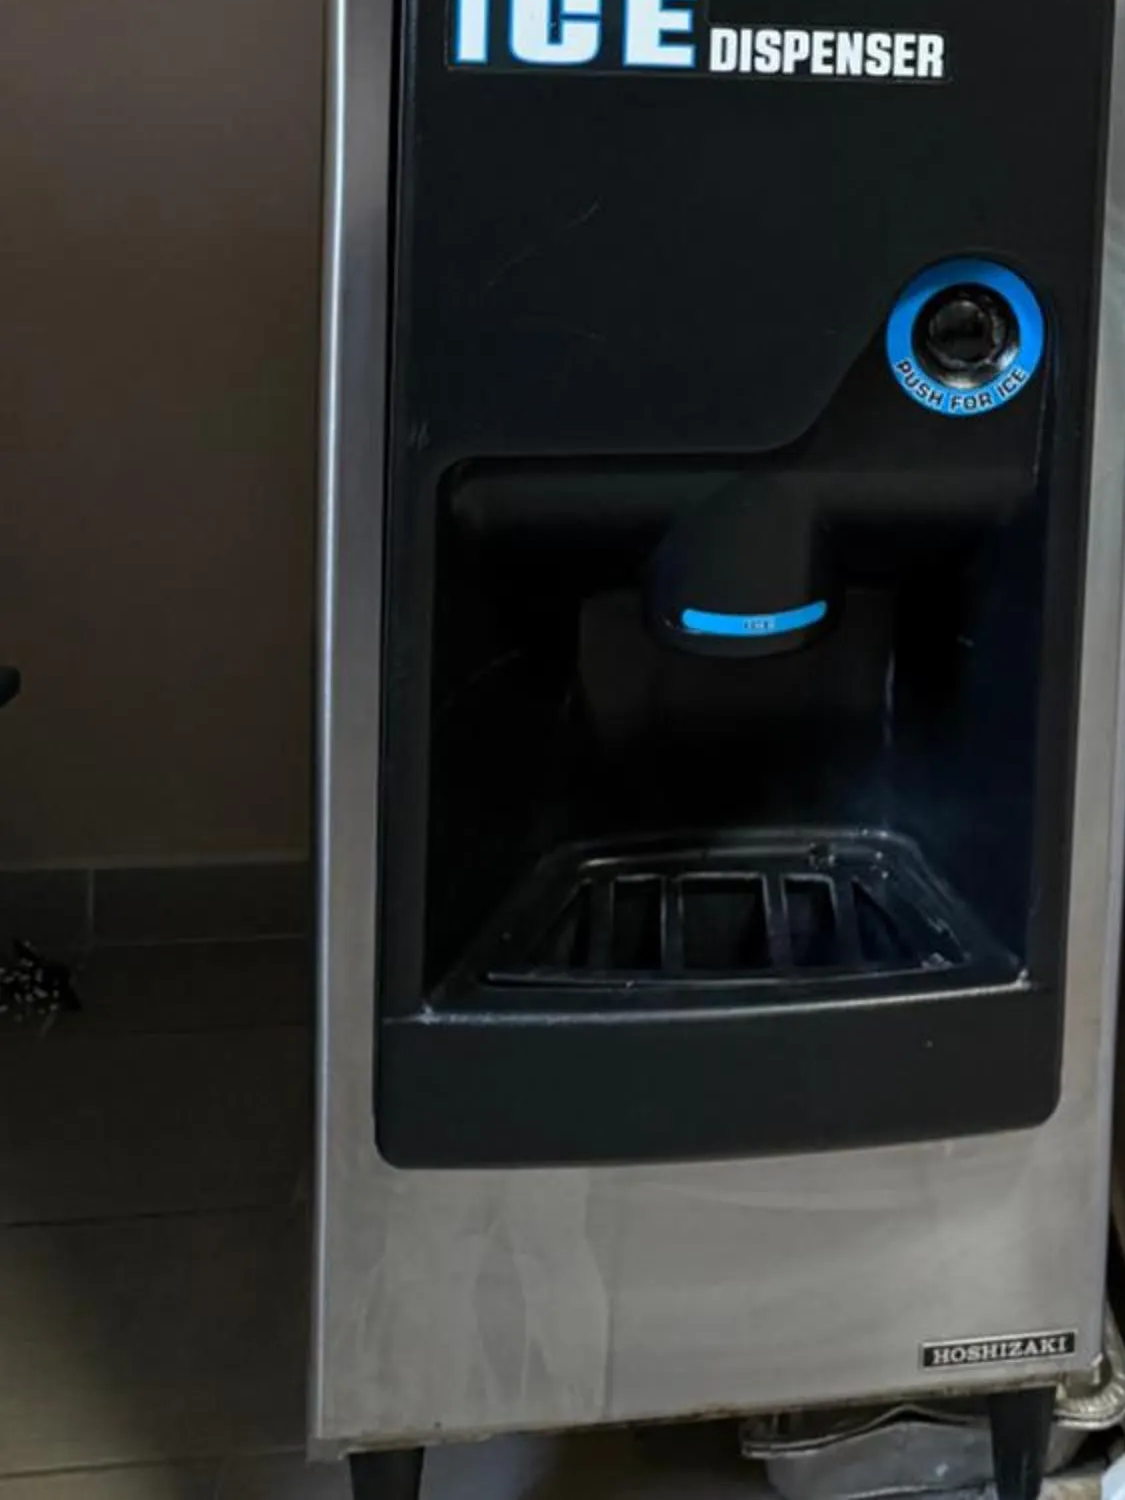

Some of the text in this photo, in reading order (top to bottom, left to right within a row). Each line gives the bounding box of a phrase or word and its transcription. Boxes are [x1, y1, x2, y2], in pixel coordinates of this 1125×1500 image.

[709, 26, 945, 78] DISPENSER
[896, 358, 1027, 411] PUSH FOR ICE
[932, 1335, 1068, 1365] HOSHIZAKI
